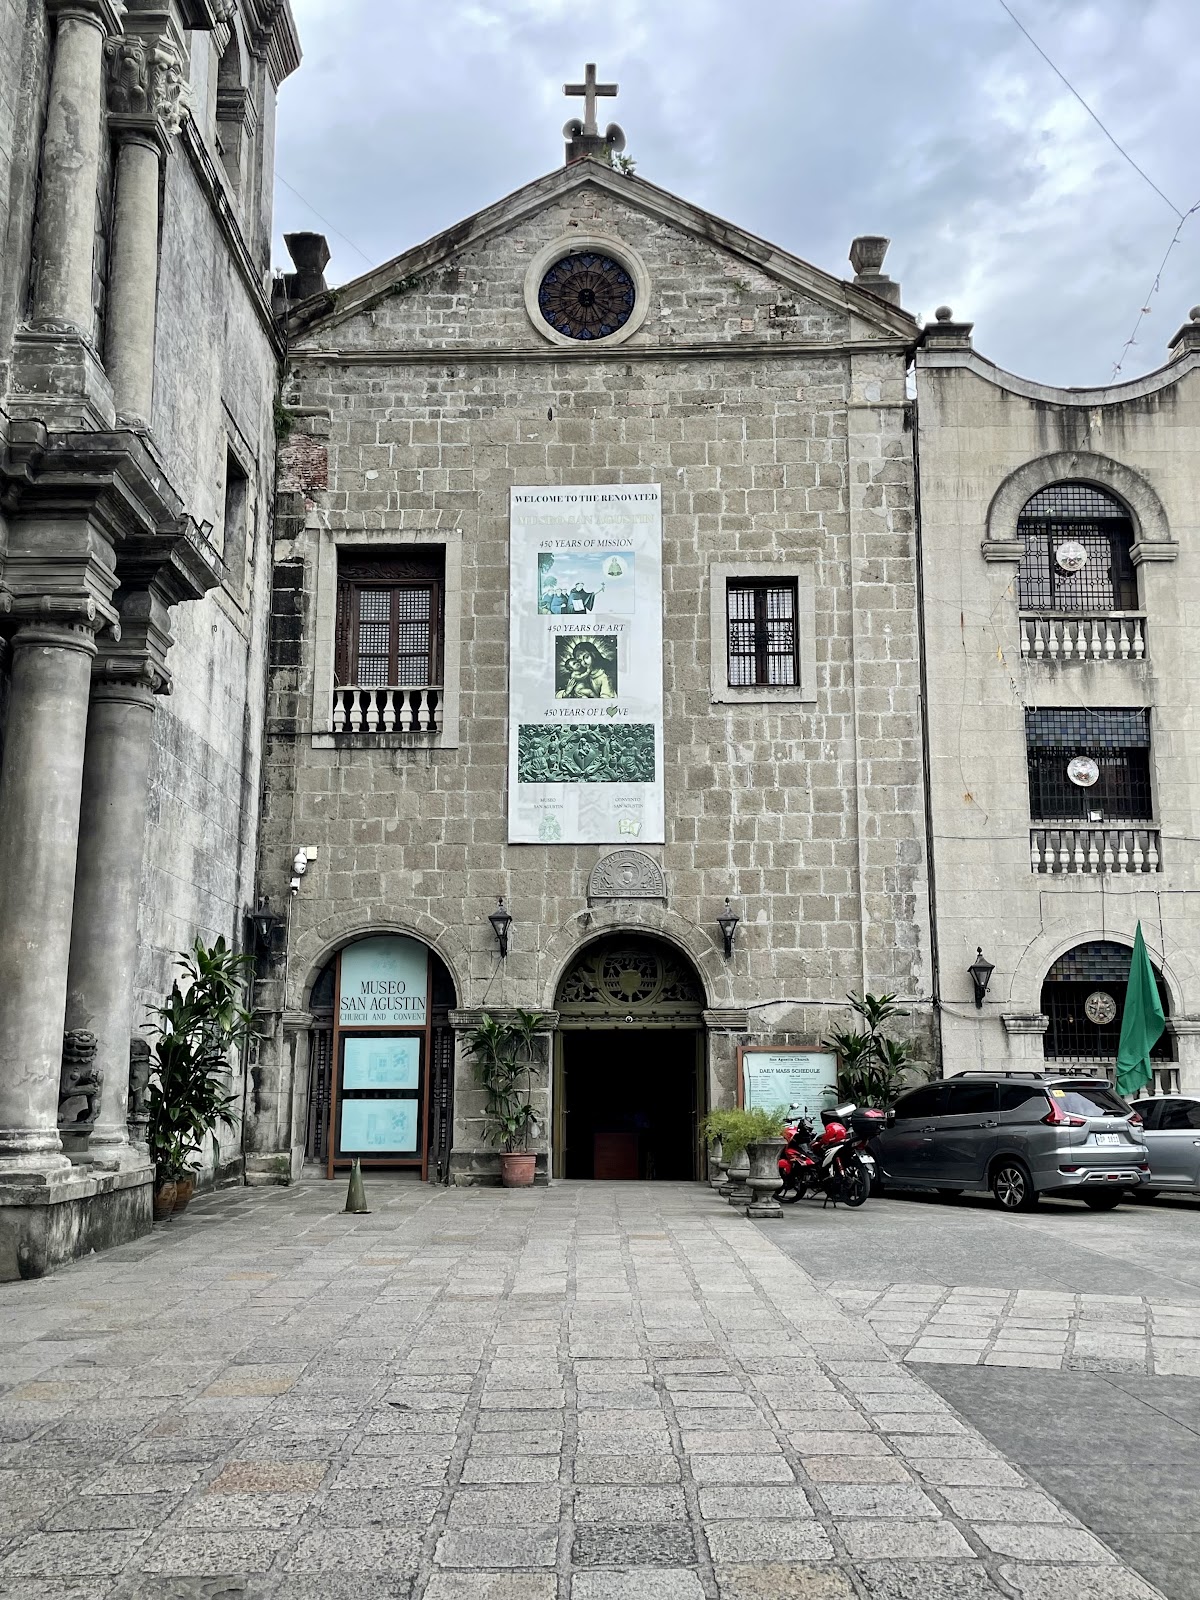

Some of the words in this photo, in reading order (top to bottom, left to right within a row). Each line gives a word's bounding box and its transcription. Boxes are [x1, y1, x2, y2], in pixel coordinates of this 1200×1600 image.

[515, 495, 563, 503] WELCOME
[579, 494, 599, 502] THE
[601, 493, 658, 502] RENOVATED
[567, 515, 593, 525] SAN
[540, 540, 553, 548] 450
[555, 540, 581, 548] YEARS
[583, 539, 595, 547] OF
[597, 539, 633, 547] MISSION
[564, 624, 591, 632] YEARS
[559, 708, 585, 716] YEARS
[587, 708, 599, 716] OF
[360, 980, 406, 995] MUSEO
[340, 996, 367, 1011] SAN
[369, 996, 427, 1011] AGUSTIN
[340, 1013, 368, 1021] CHURCH
[372, 1013, 386, 1021] AND
[393, 1012, 426, 1020] CONVENT
